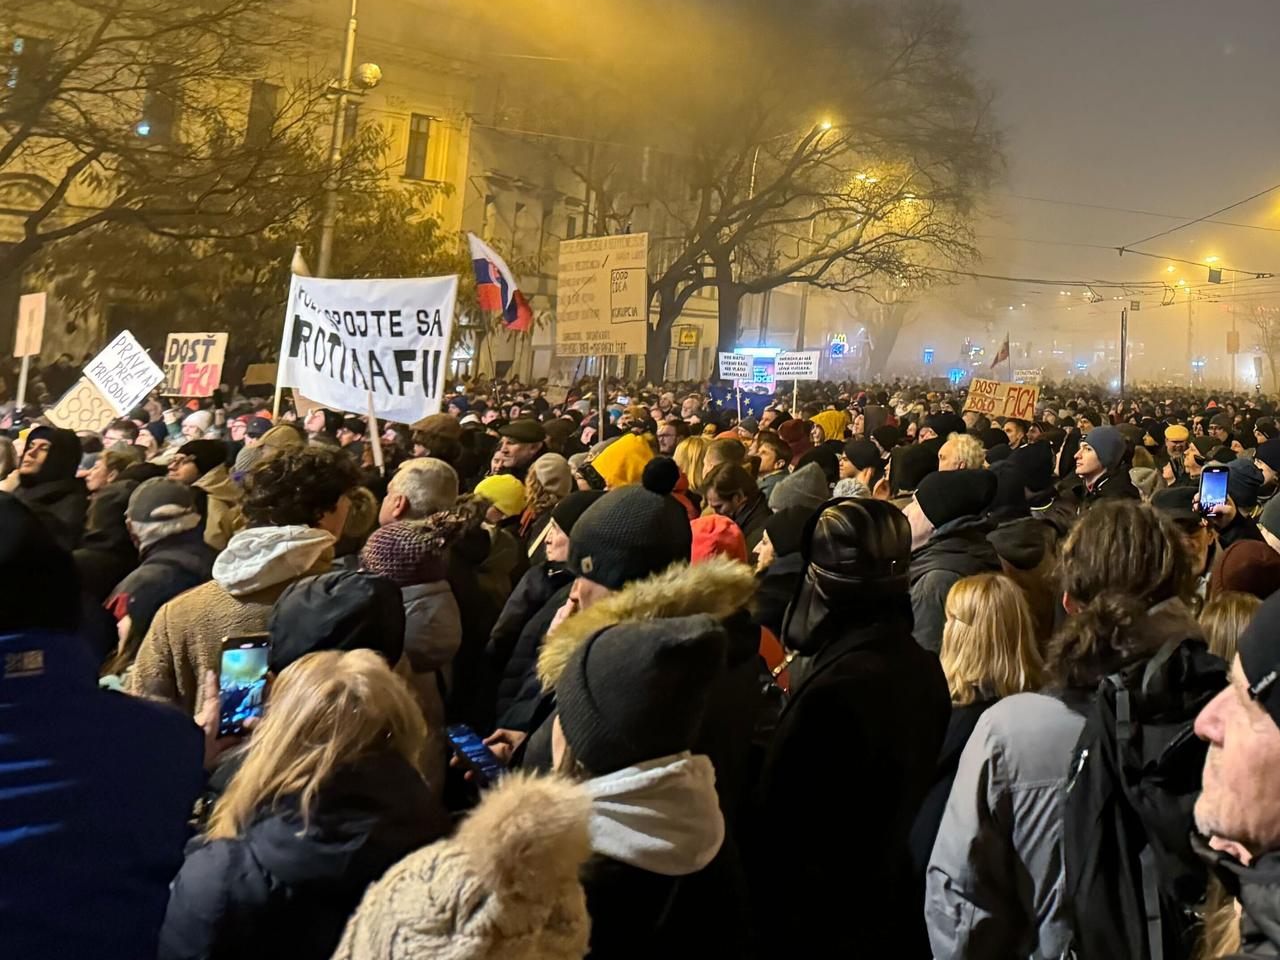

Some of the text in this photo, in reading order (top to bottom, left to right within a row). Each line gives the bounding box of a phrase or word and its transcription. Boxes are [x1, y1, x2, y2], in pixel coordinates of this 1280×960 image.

[611, 271, 628, 282] GOOD
[416, 309, 443, 337] SA
[167, 334, 216, 363] DOSŤ
[110, 360, 133, 385] PRE
[1003, 386, 1036, 419] FICA
